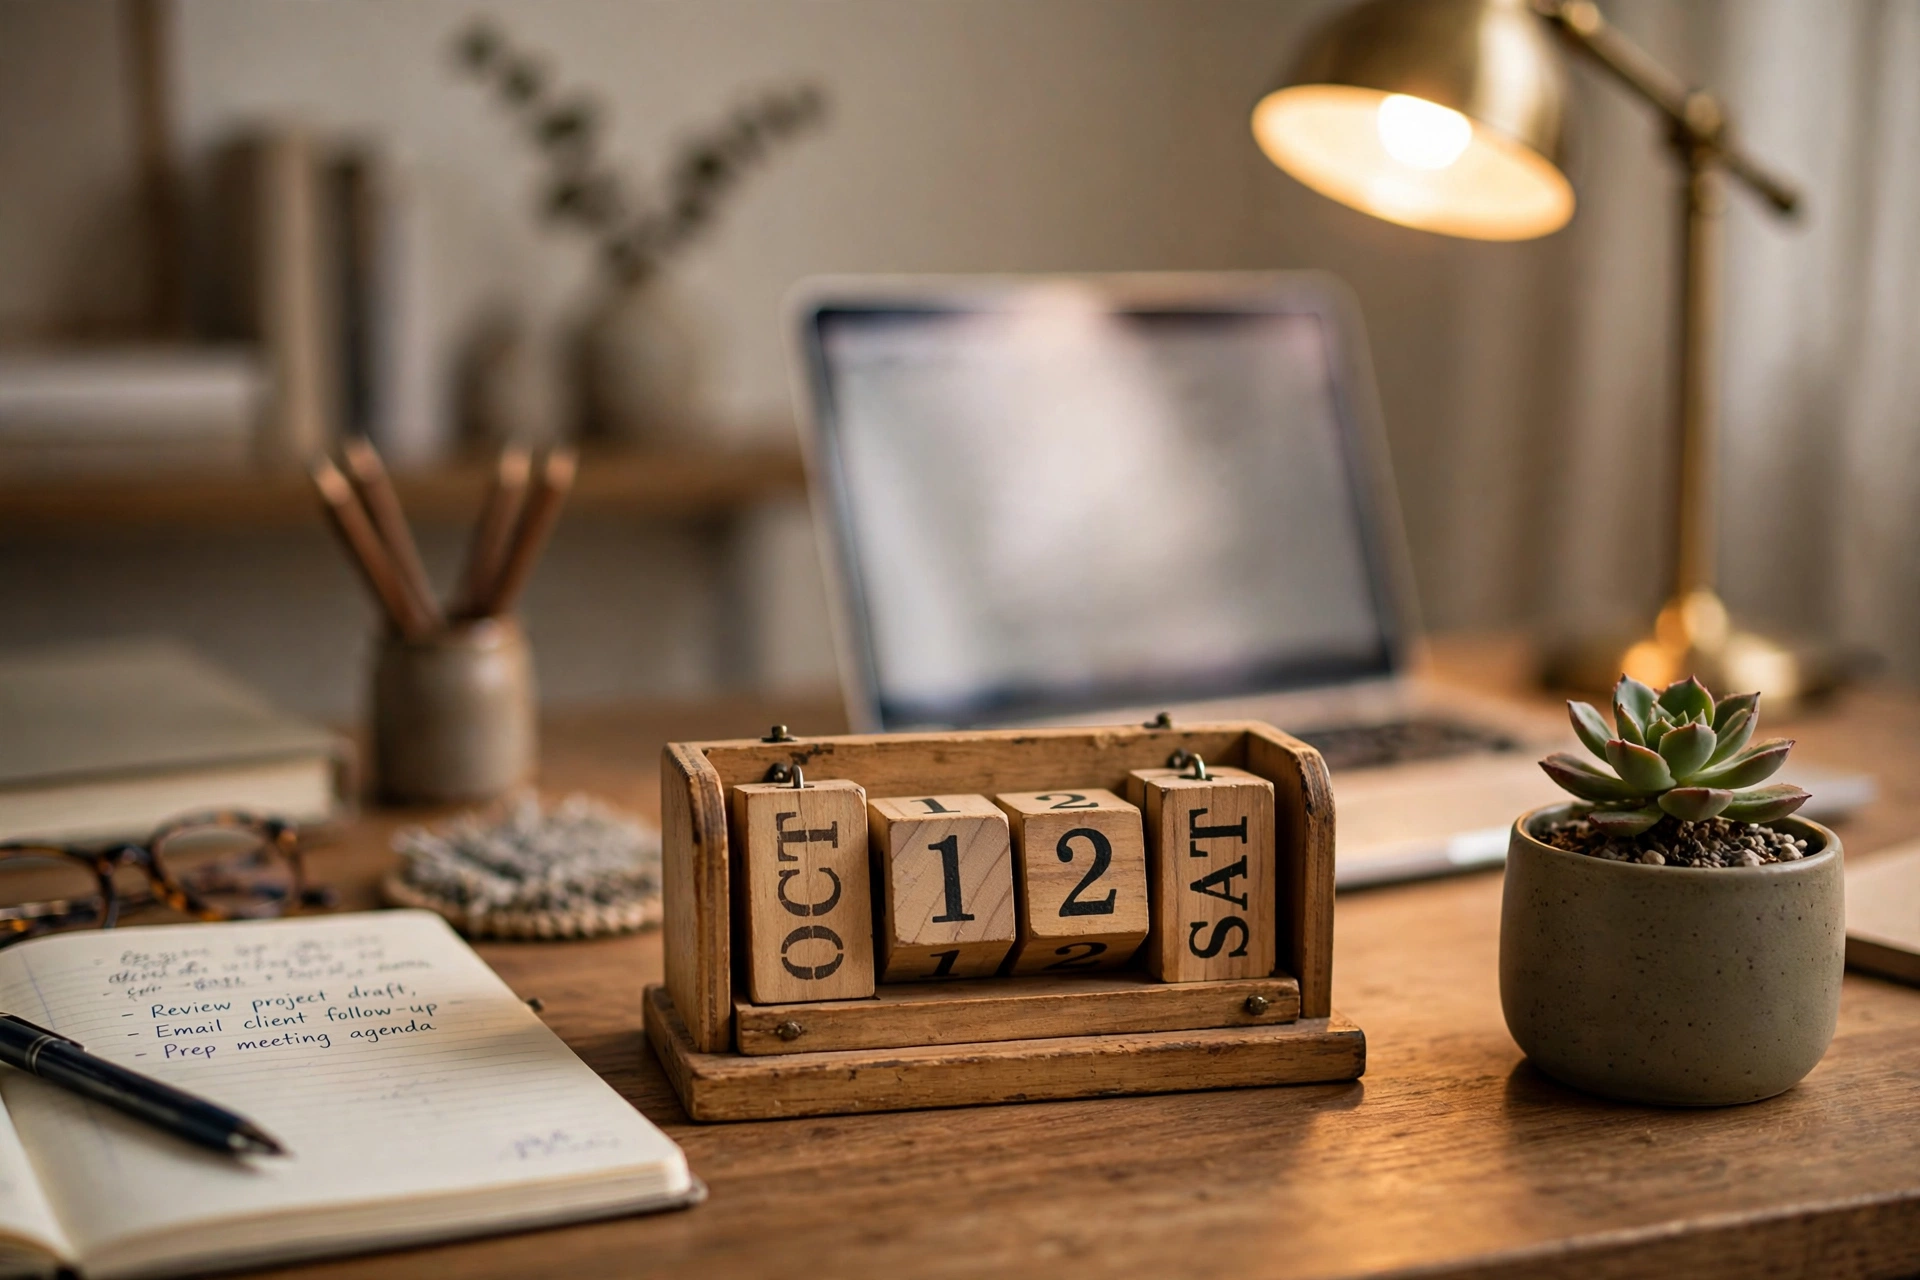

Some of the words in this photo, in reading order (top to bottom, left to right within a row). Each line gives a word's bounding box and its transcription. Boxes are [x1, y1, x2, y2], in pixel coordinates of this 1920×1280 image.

[911, 798, 961, 815] 1
[1035, 793, 1099, 809] 2
[928, 835, 975, 923] 1
[1056, 828, 1117, 917] 2
[1189, 808, 1250, 958] SAT
[775, 812, 844, 980] OCT
[919, 950, 960, 978] 1
[1043, 942, 1108, 970] 2
[151, 1001, 231, 1018] Review
[252, 992, 327, 1013] project
[348, 983, 416, 1000] draft,
[156, 1018, 223, 1039] Email
[243, 1012, 308, 1030] client
[324, 1002, 438, 1022] follow-up
[164, 1043, 217, 1060] Prep
[237, 1032, 331, 1049] meeting
[350, 1019, 437, 1043] agenda
